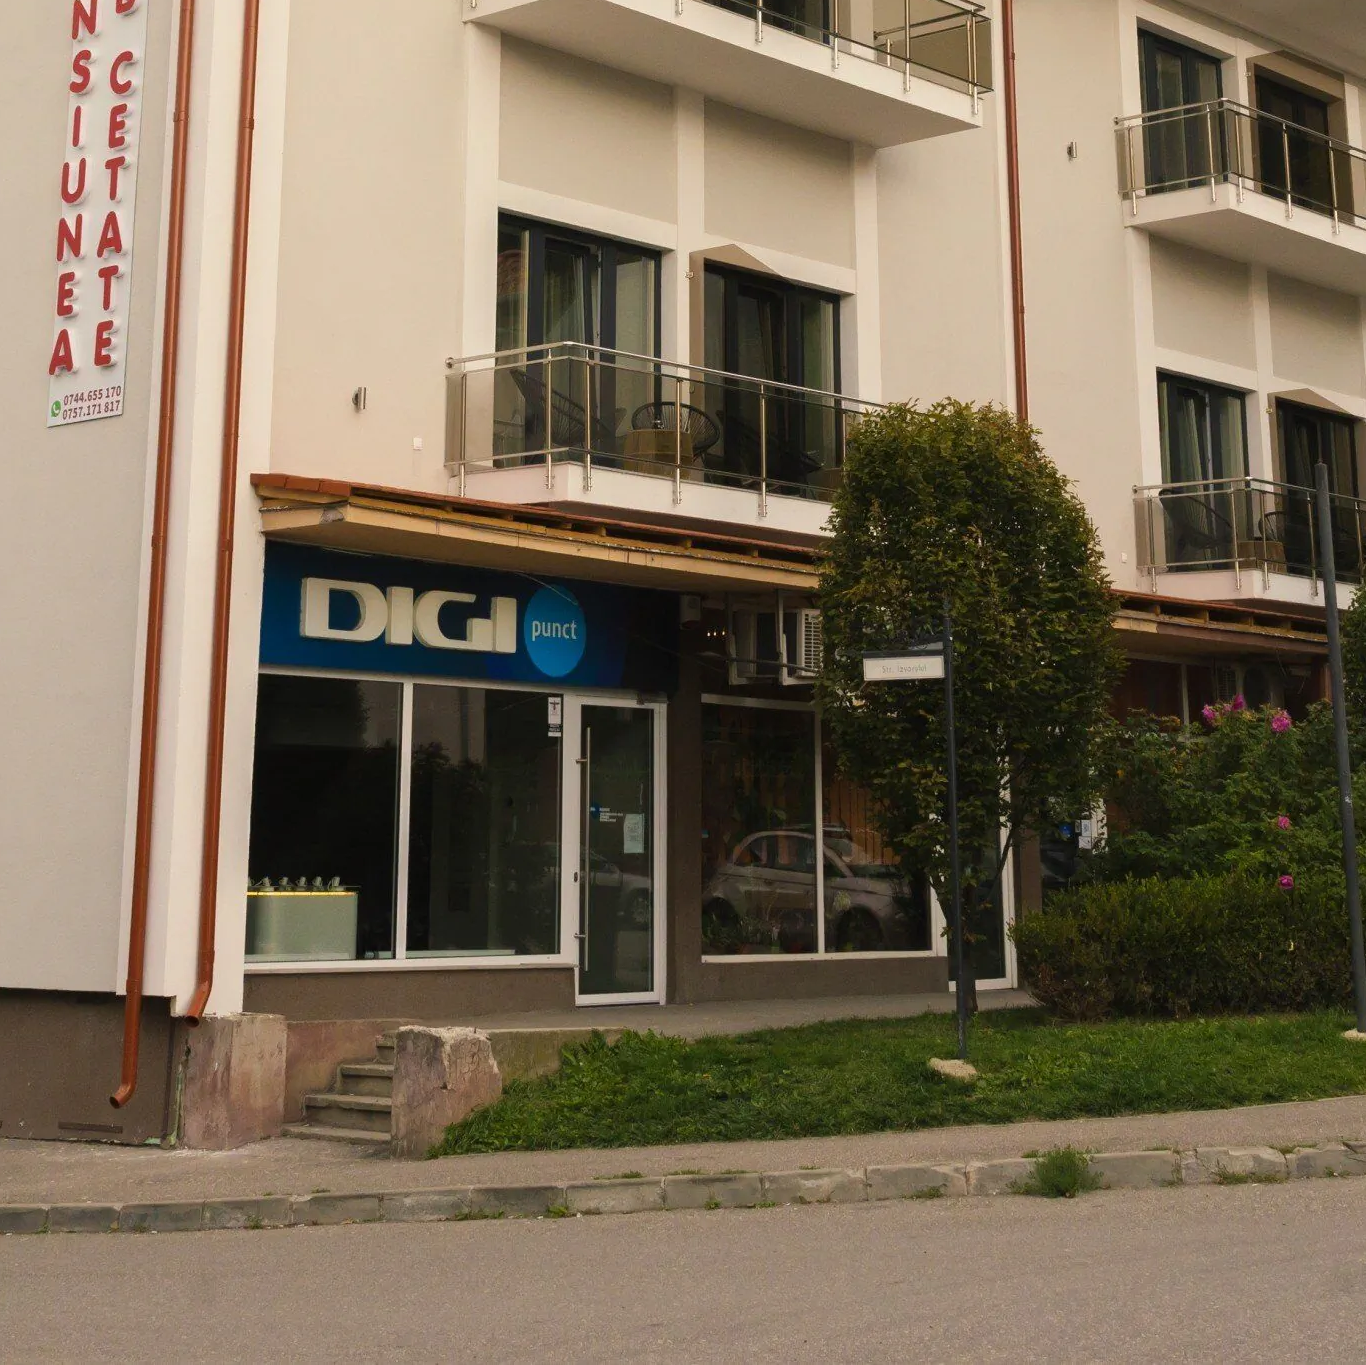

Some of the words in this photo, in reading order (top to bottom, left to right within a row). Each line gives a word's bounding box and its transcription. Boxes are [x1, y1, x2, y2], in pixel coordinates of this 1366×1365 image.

[93, 51, 134, 367] CETATE
[63, 389, 103, 406] 0744.655
[105, 385, 122, 398] 170
[62, 404, 102, 420] 0757.171
[104, 400, 121, 413] 817
[300, 577, 517, 653] DIGI
[531, 618, 578, 641] punct
